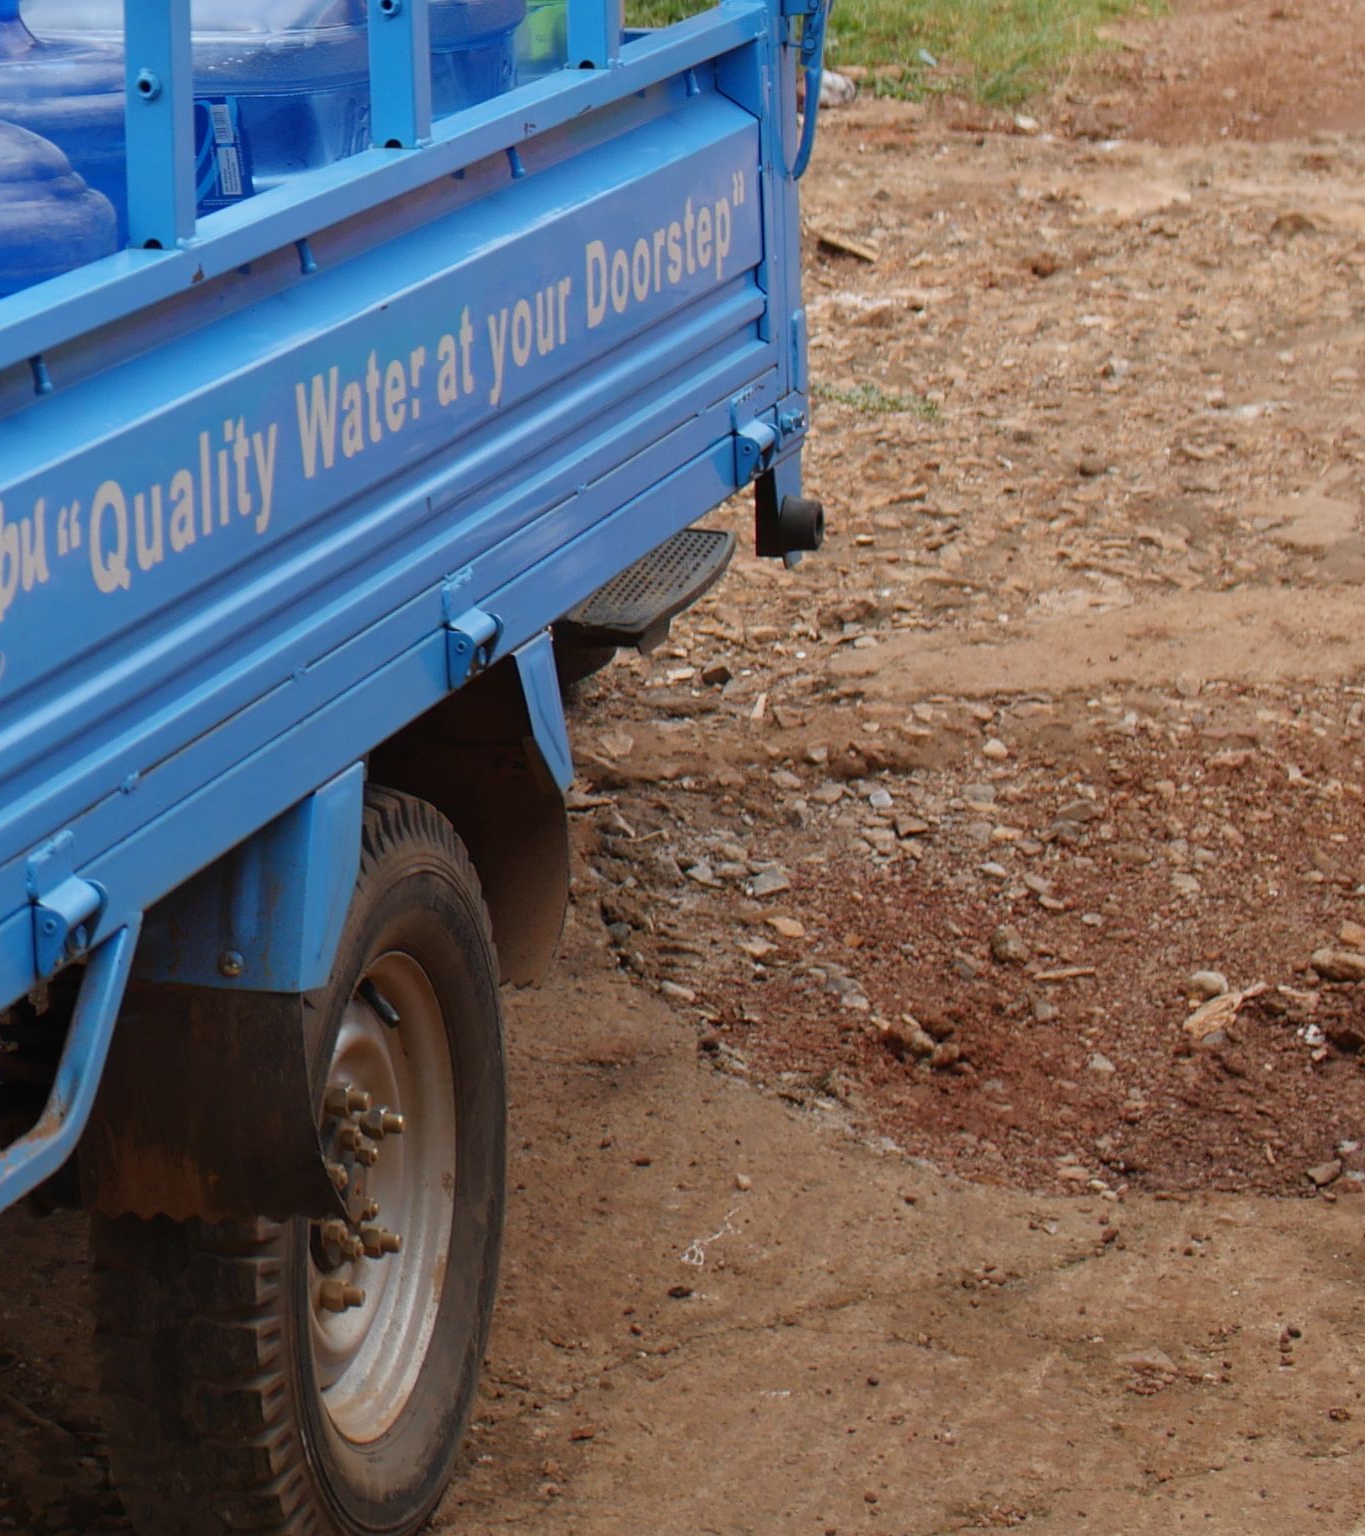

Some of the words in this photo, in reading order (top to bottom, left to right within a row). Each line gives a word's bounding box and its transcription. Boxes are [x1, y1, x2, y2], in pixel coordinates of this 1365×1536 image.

[296, 340, 427, 482] Water
[437, 304, 475, 405] at
[487, 272, 572, 408] your
